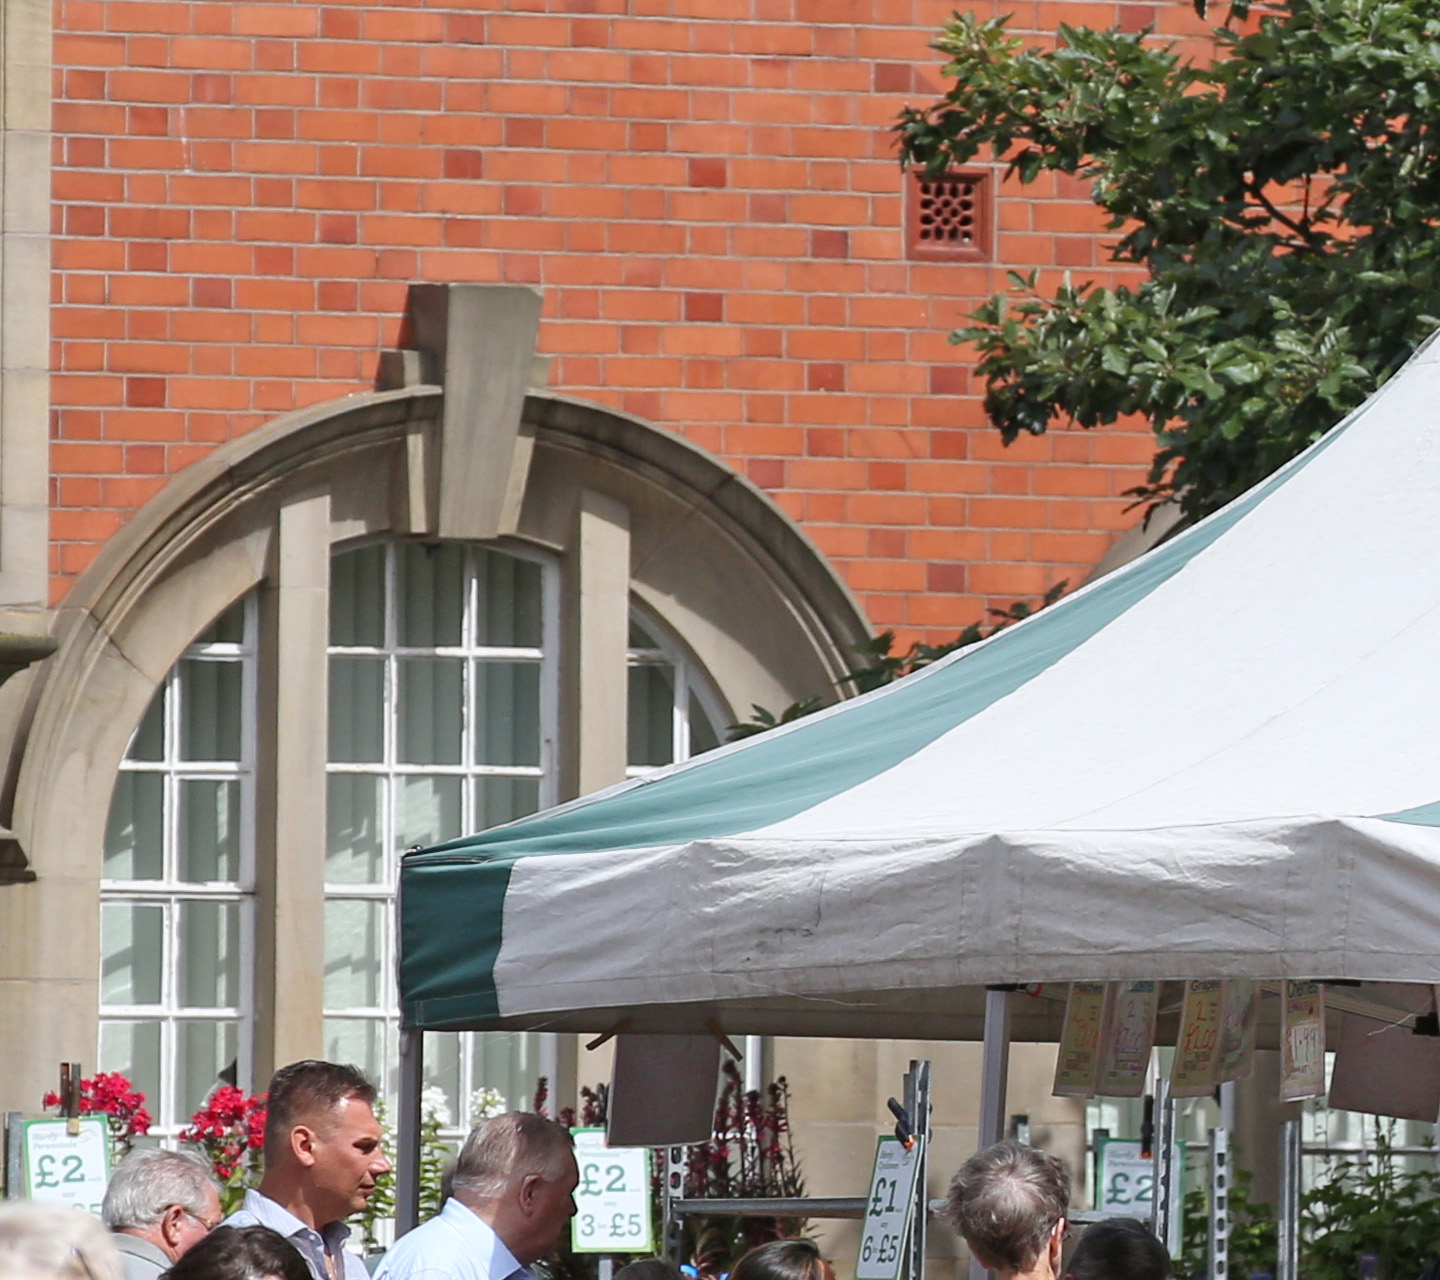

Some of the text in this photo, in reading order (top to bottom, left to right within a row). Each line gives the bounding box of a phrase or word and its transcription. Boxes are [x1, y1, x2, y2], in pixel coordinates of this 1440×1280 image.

[34, 1154, 85, 1189] £2
[580, 1163, 627, 1196] £2
[869, 1176, 898, 1217] £1
[1106, 1172, 1153, 1205] £2
[581, 1214, 595, 1237] 3
[609, 1213, 642, 1237] £5
[862, 1233, 899, 1264] 6 £5
